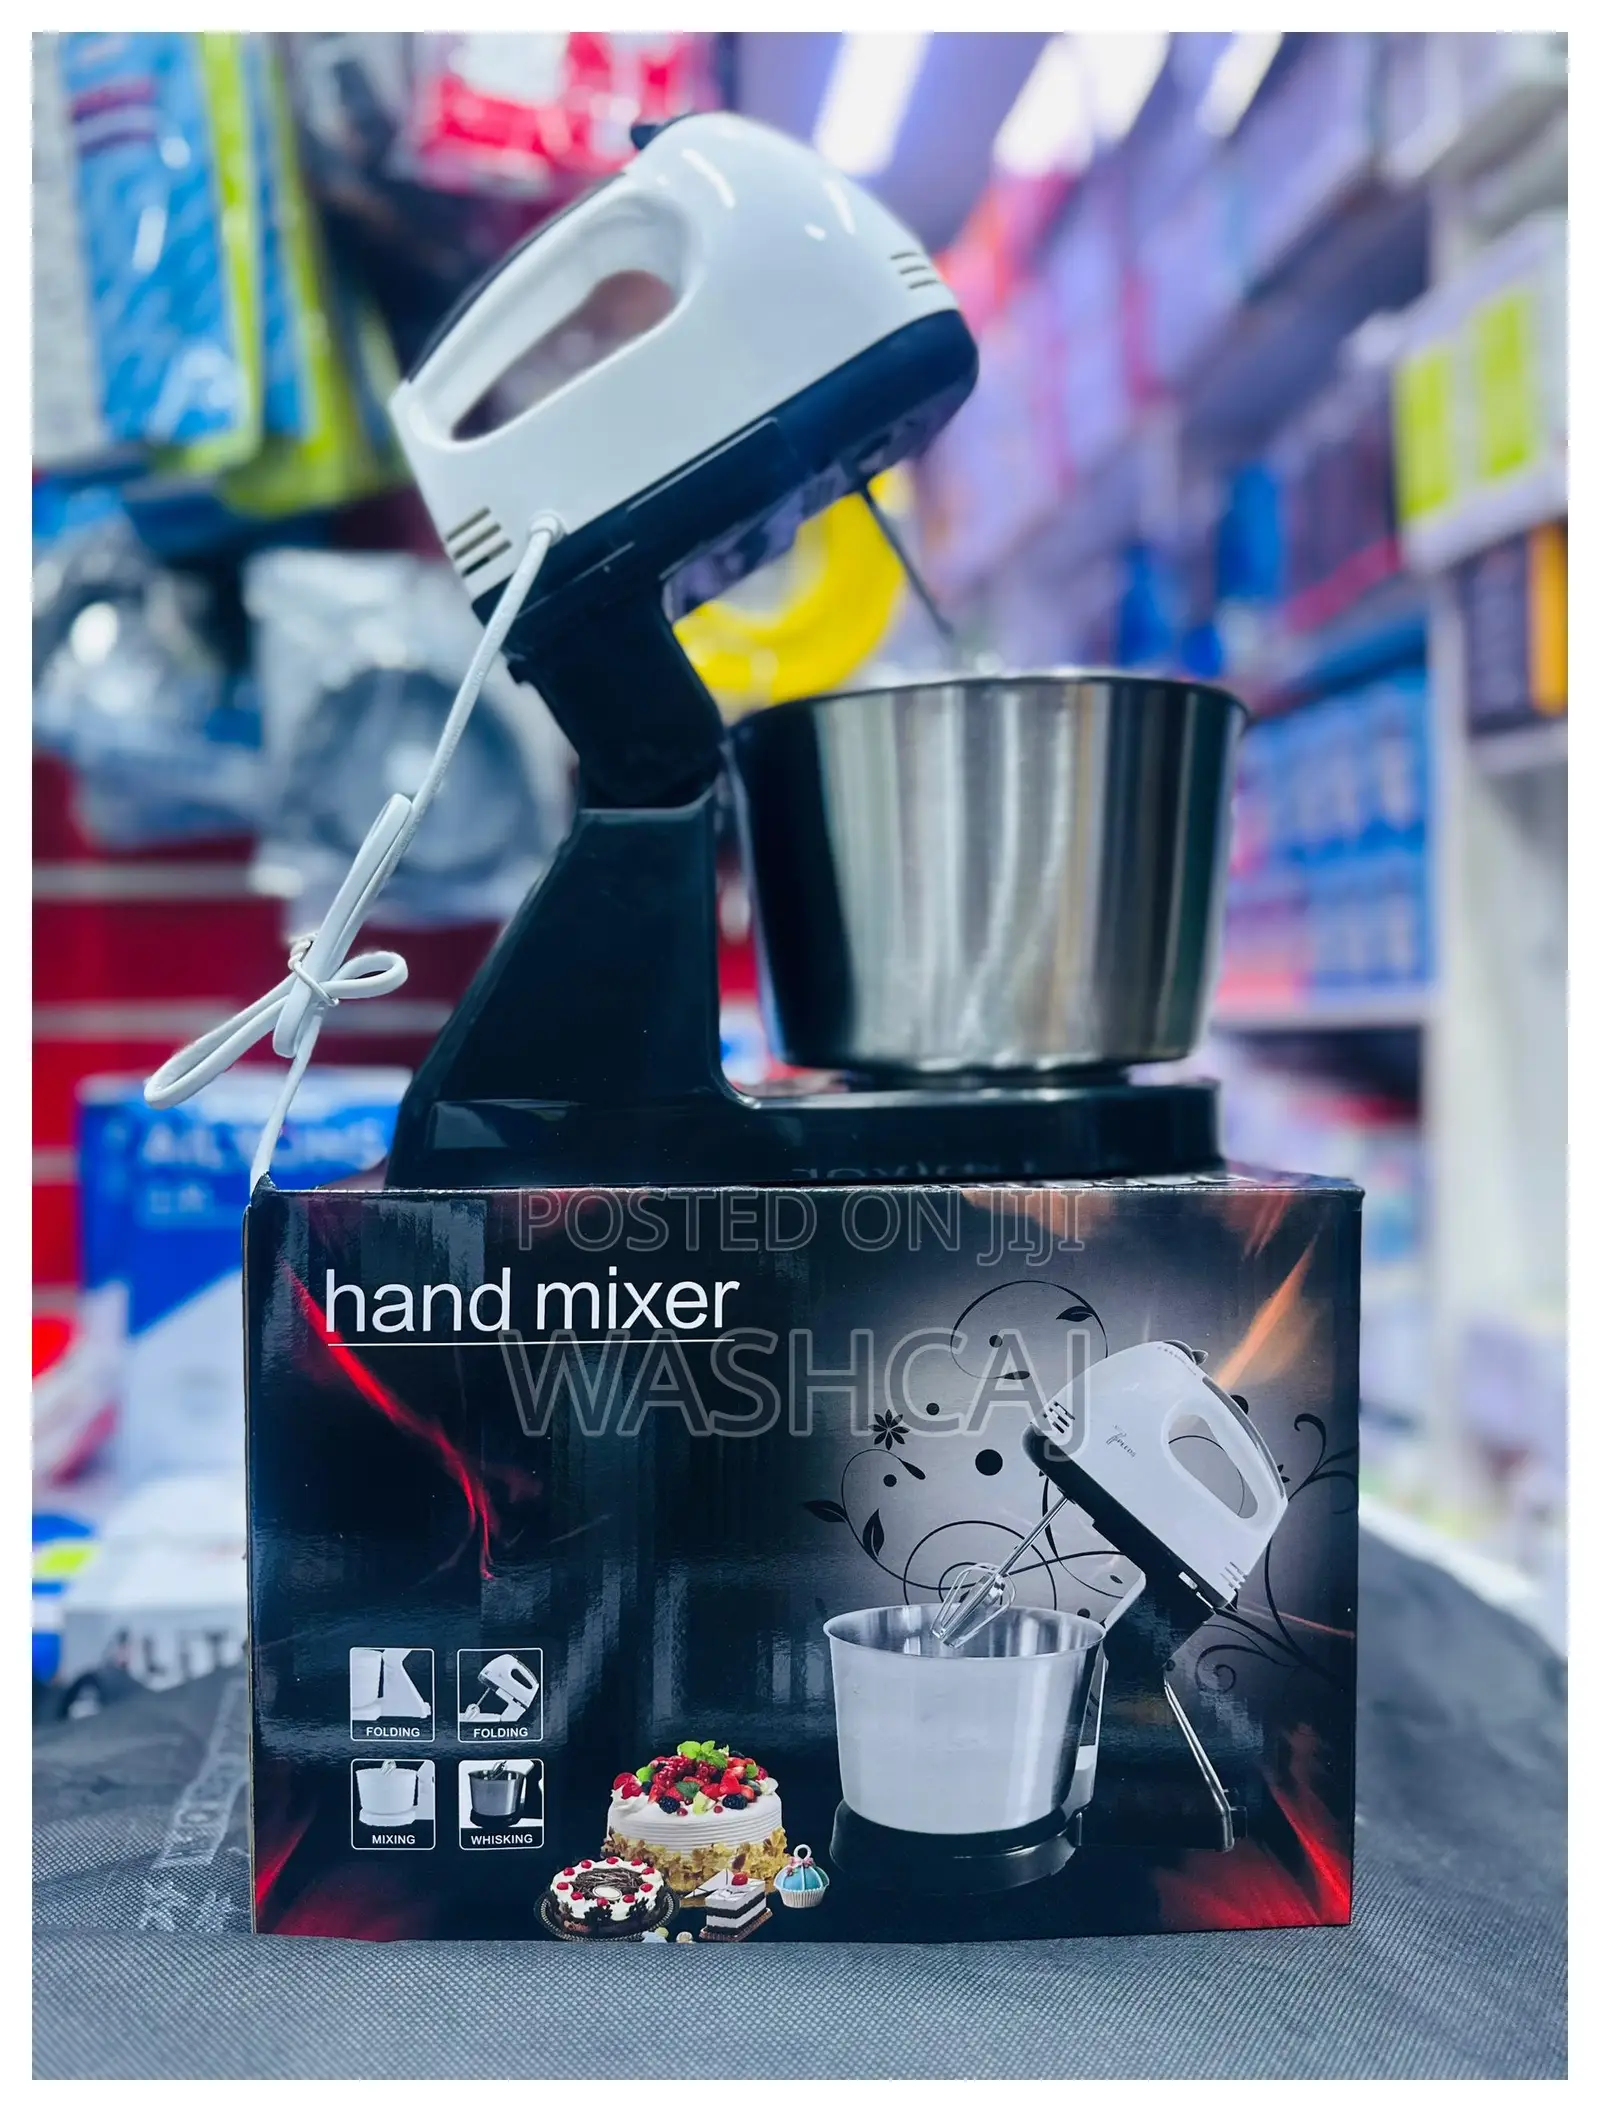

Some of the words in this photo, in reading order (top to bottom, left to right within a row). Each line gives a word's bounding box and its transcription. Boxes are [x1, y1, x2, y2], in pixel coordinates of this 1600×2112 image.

[325, 1267, 511, 1332] hand
[536, 1265, 741, 1330] mixer
[366, 1726, 421, 1738] FOLDING
[473, 1727, 529, 1739] FOLDING
[372, 1834, 416, 1845] MIXING
[470, 1833, 533, 1846] WHISKING
